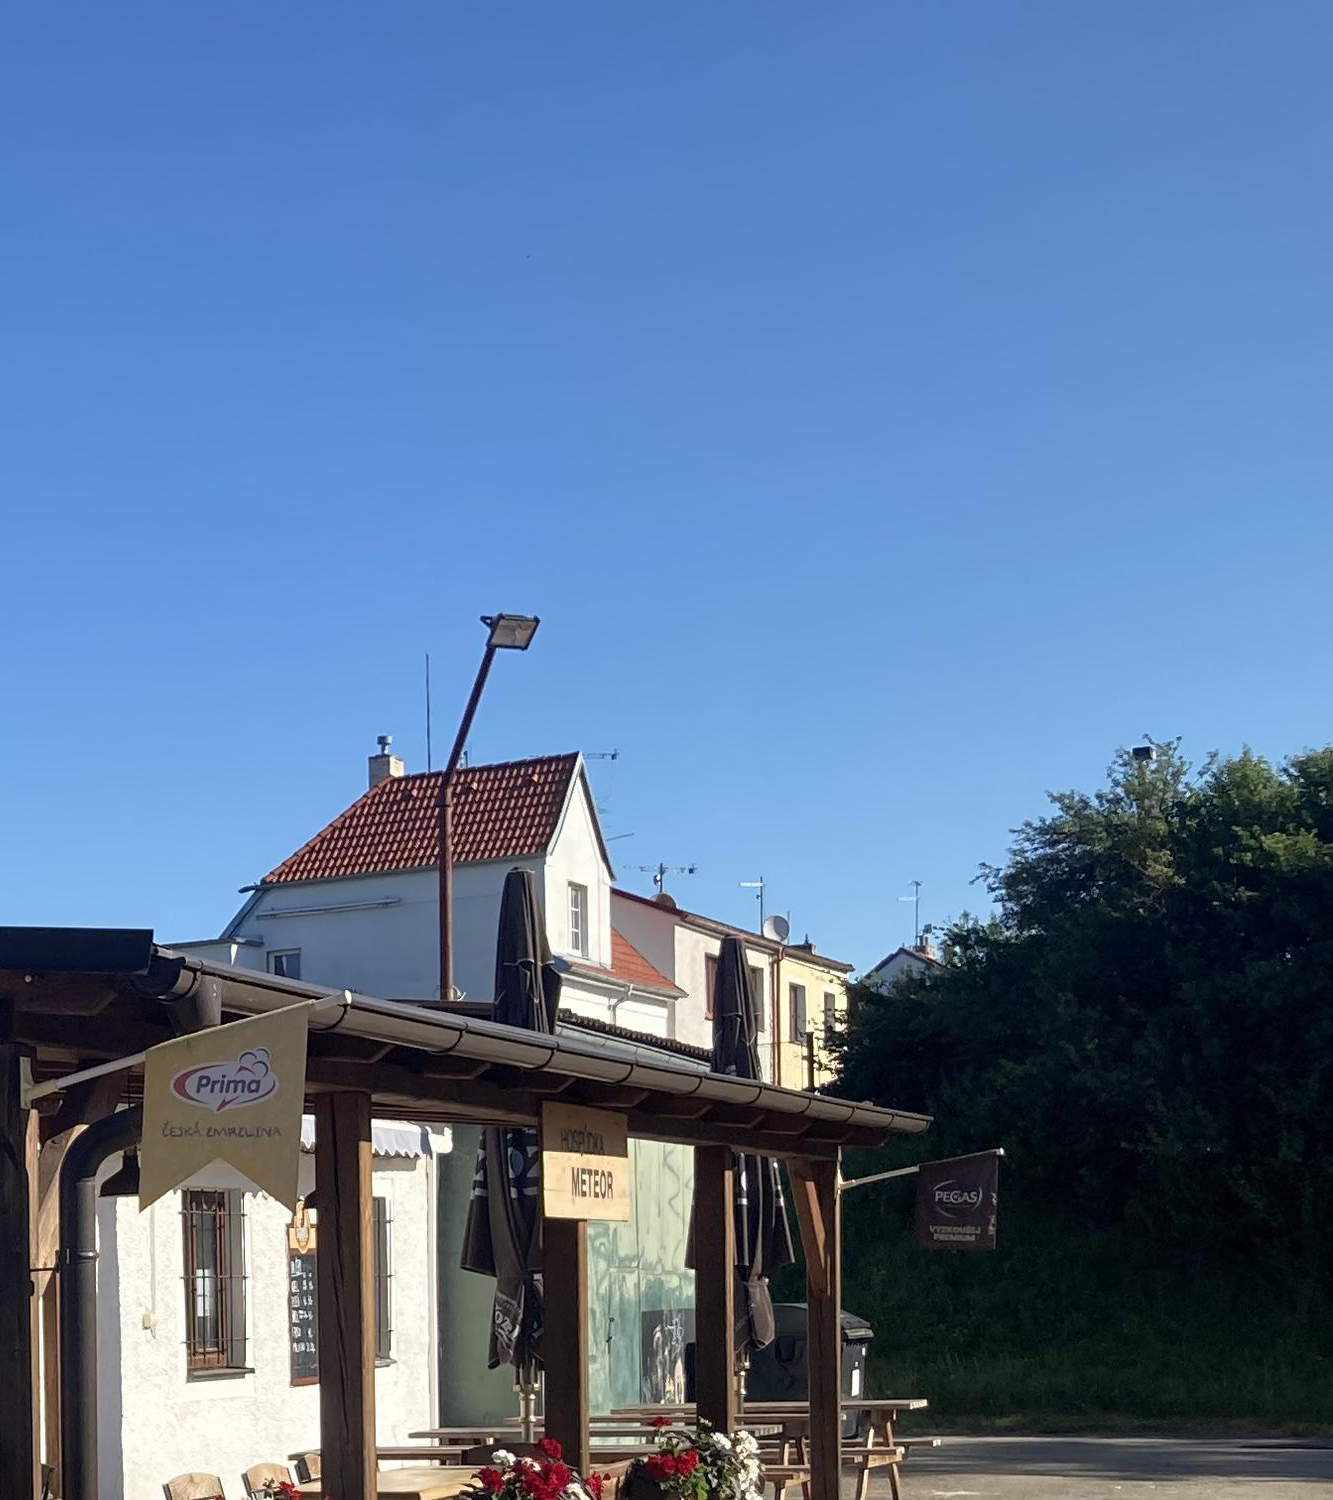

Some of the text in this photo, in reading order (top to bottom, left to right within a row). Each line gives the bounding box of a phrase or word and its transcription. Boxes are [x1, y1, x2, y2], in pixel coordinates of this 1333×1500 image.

[196, 1074, 261, 1095] Prima
[162, 1118, 202, 1138] ČESKÁ
[571, 1166, 614, 1200] METEOR
[934, 1190, 978, 1204] PEGAS
